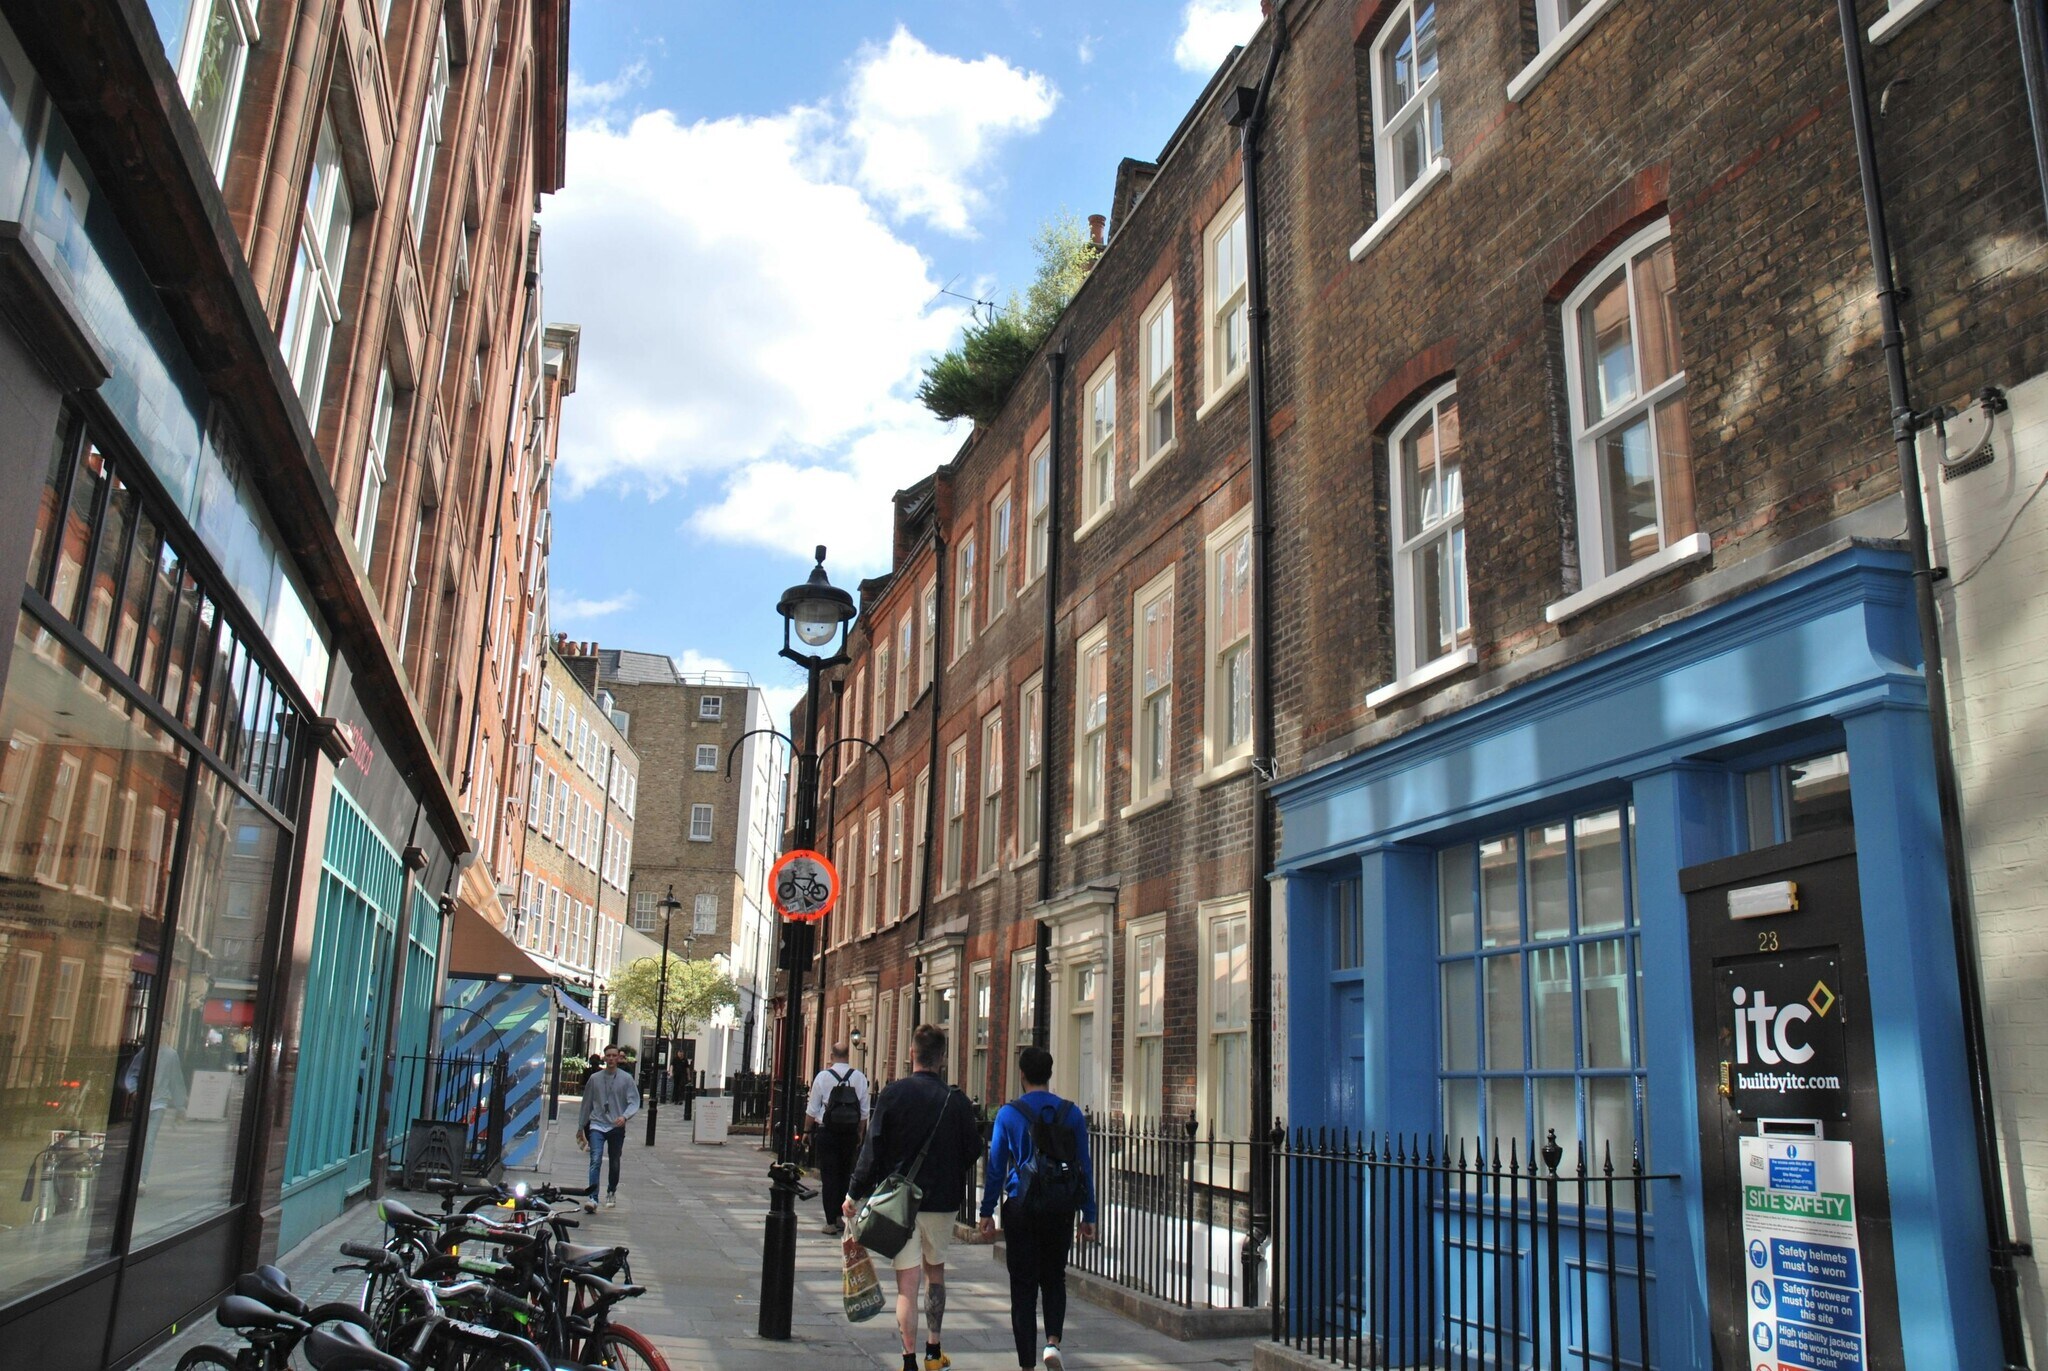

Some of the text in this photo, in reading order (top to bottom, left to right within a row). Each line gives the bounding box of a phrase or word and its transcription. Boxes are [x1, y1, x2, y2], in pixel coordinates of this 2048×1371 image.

[804, 819, 810, 829] 1
[1759, 931, 1778, 951] 23
[1733, 986, 1815, 1064] itc
[1738, 1072, 1840, 1093] builtbyitc.com
[1749, 1190, 1845, 1216] SITE SAFETY
[1779, 1245, 1847, 1264] Safety helmets
[1783, 1260, 1846, 1278] must be worn
[1783, 1283, 1850, 1303] Safety footwear
[847, 1294, 880, 1313] WORLD
[1782, 1296, 1852, 1316] must be worn on
[1801, 1310, 1834, 1324] this site
[1779, 1325, 1859, 1351] High visibility jackets
[1779, 1337, 1859, 1362] must be worn beyond
[1801, 1352, 1837, 1368] this point
